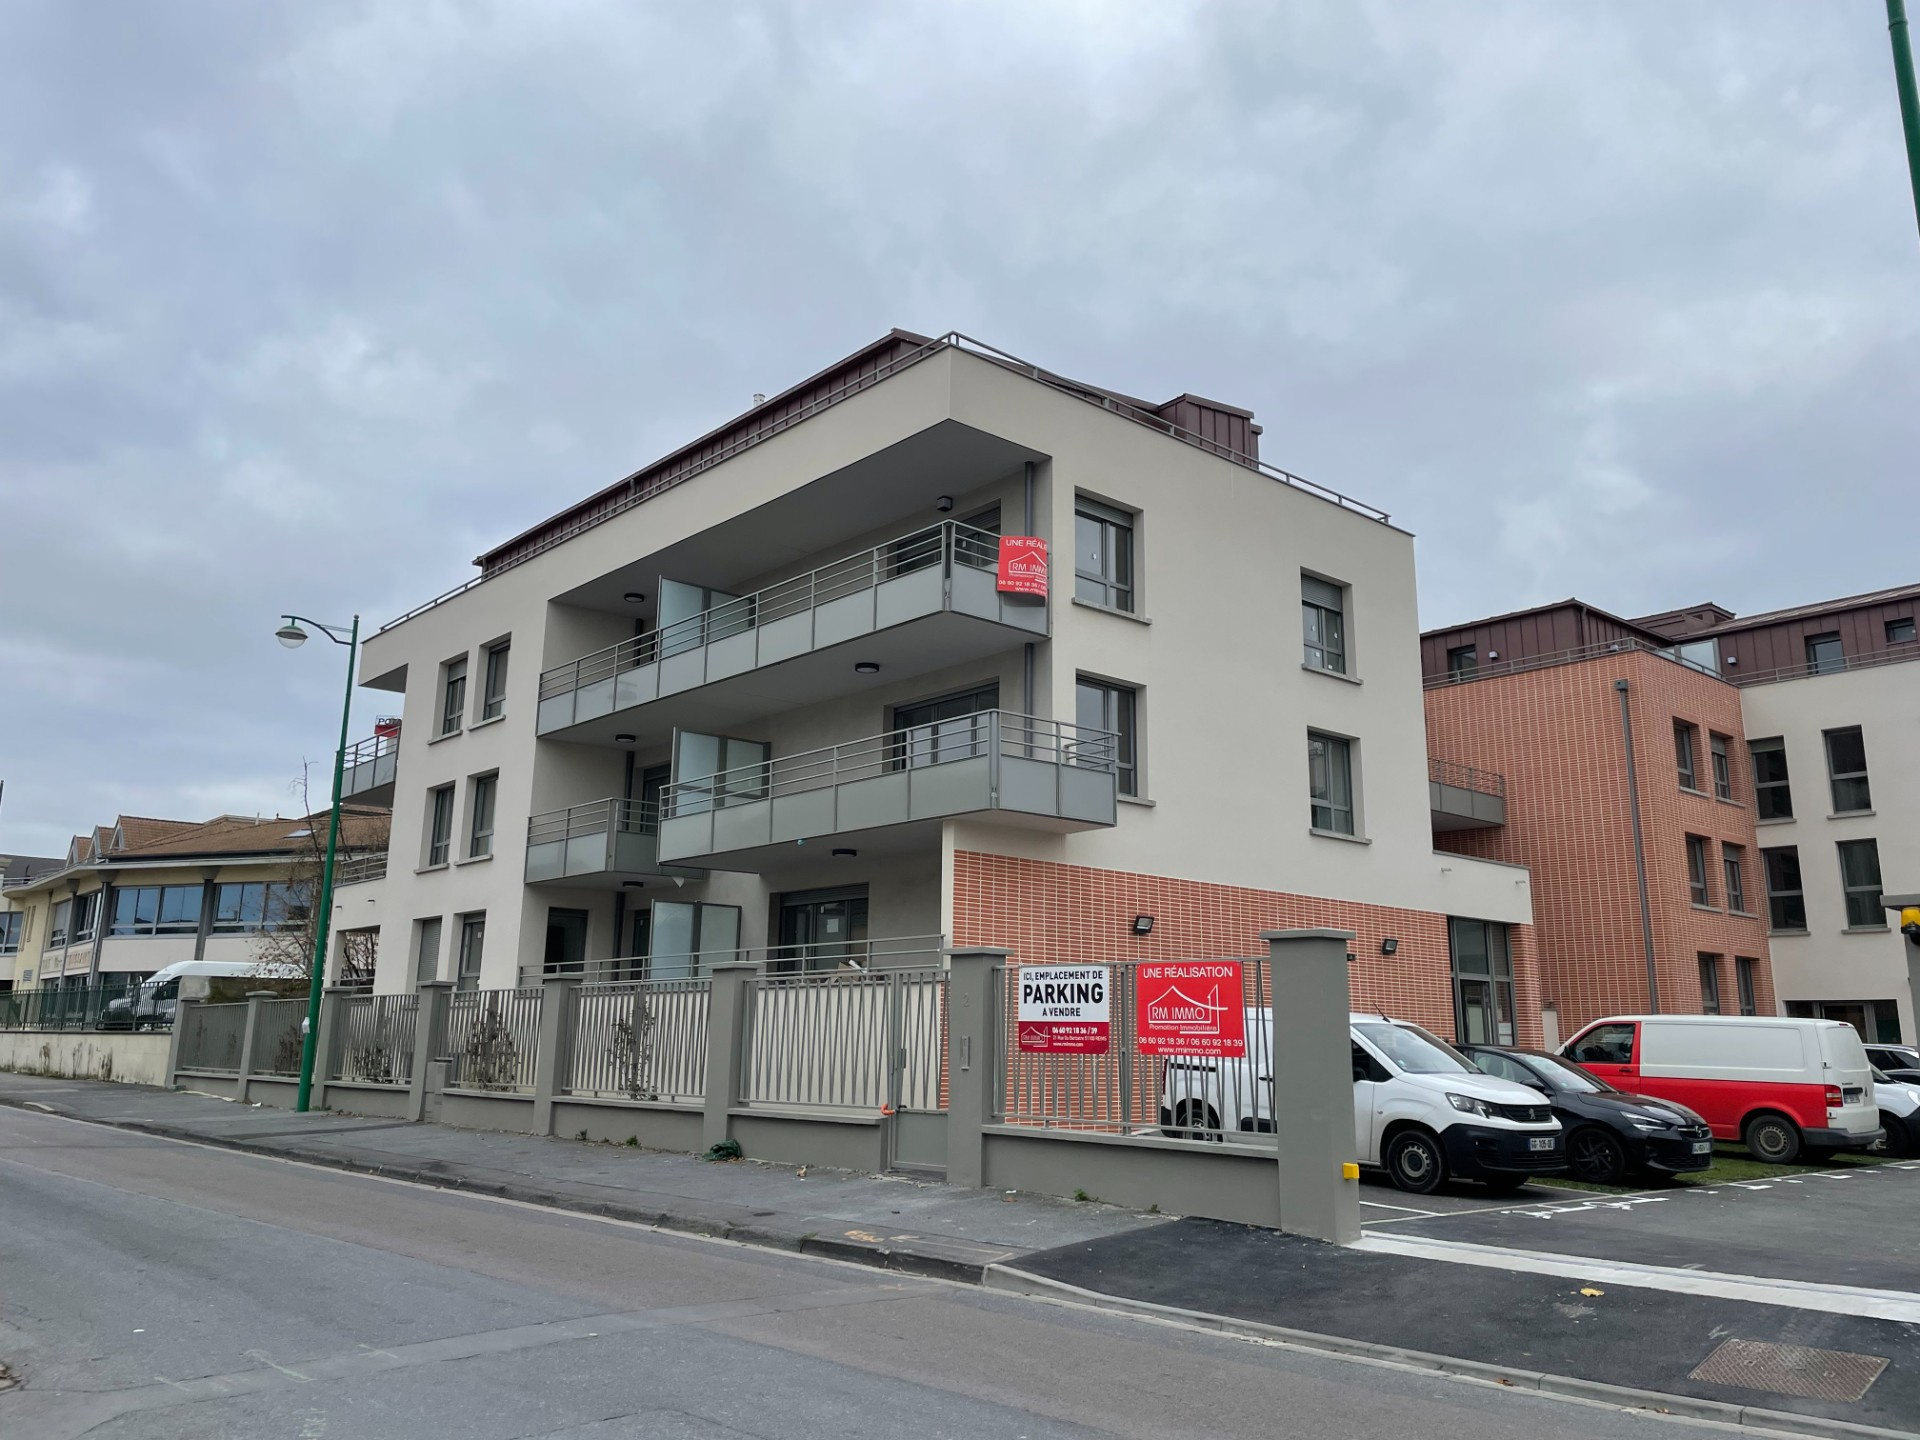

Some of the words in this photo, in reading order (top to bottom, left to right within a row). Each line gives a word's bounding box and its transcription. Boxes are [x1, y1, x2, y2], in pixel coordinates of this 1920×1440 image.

[1006, 539, 1024, 547] UNE
[1012, 562, 1027, 572] RM
[1023, 972, 1034, 981] ICI,
[1035, 970, 1090, 980] EMPLACEMENT
[1092, 970, 1103, 979] DE
[1143, 967, 1162, 978] UNE
[1164, 965, 1232, 978] RÉALISATION
[1023, 983, 1104, 1004] PARKING
[1042, 1008, 1048, 1017] A
[1049, 1007, 1081, 1017] VENDRE
[1152, 1007, 1168, 1020] RM
[1171, 1006, 1205, 1020] IMMO
[1052, 1026, 1059, 1034] 06
[1059, 1026, 1066, 1034] 60
[1066, 1026, 1073, 1034] 92
[1139, 1036, 1147, 1044] 06
[1148, 1036, 1157, 1044] 60
[1157, 1036, 1166, 1044] 92
[1176, 1037, 1185, 1045] 36
[1190, 1038, 1200, 1046] 06
[1201, 1038, 1211, 1046] 60
[1223, 1039, 1232, 1047] 18
[1233, 1039, 1243, 1047] 39
[1158, 1046, 1221, 1055] www.rmimmo.com
